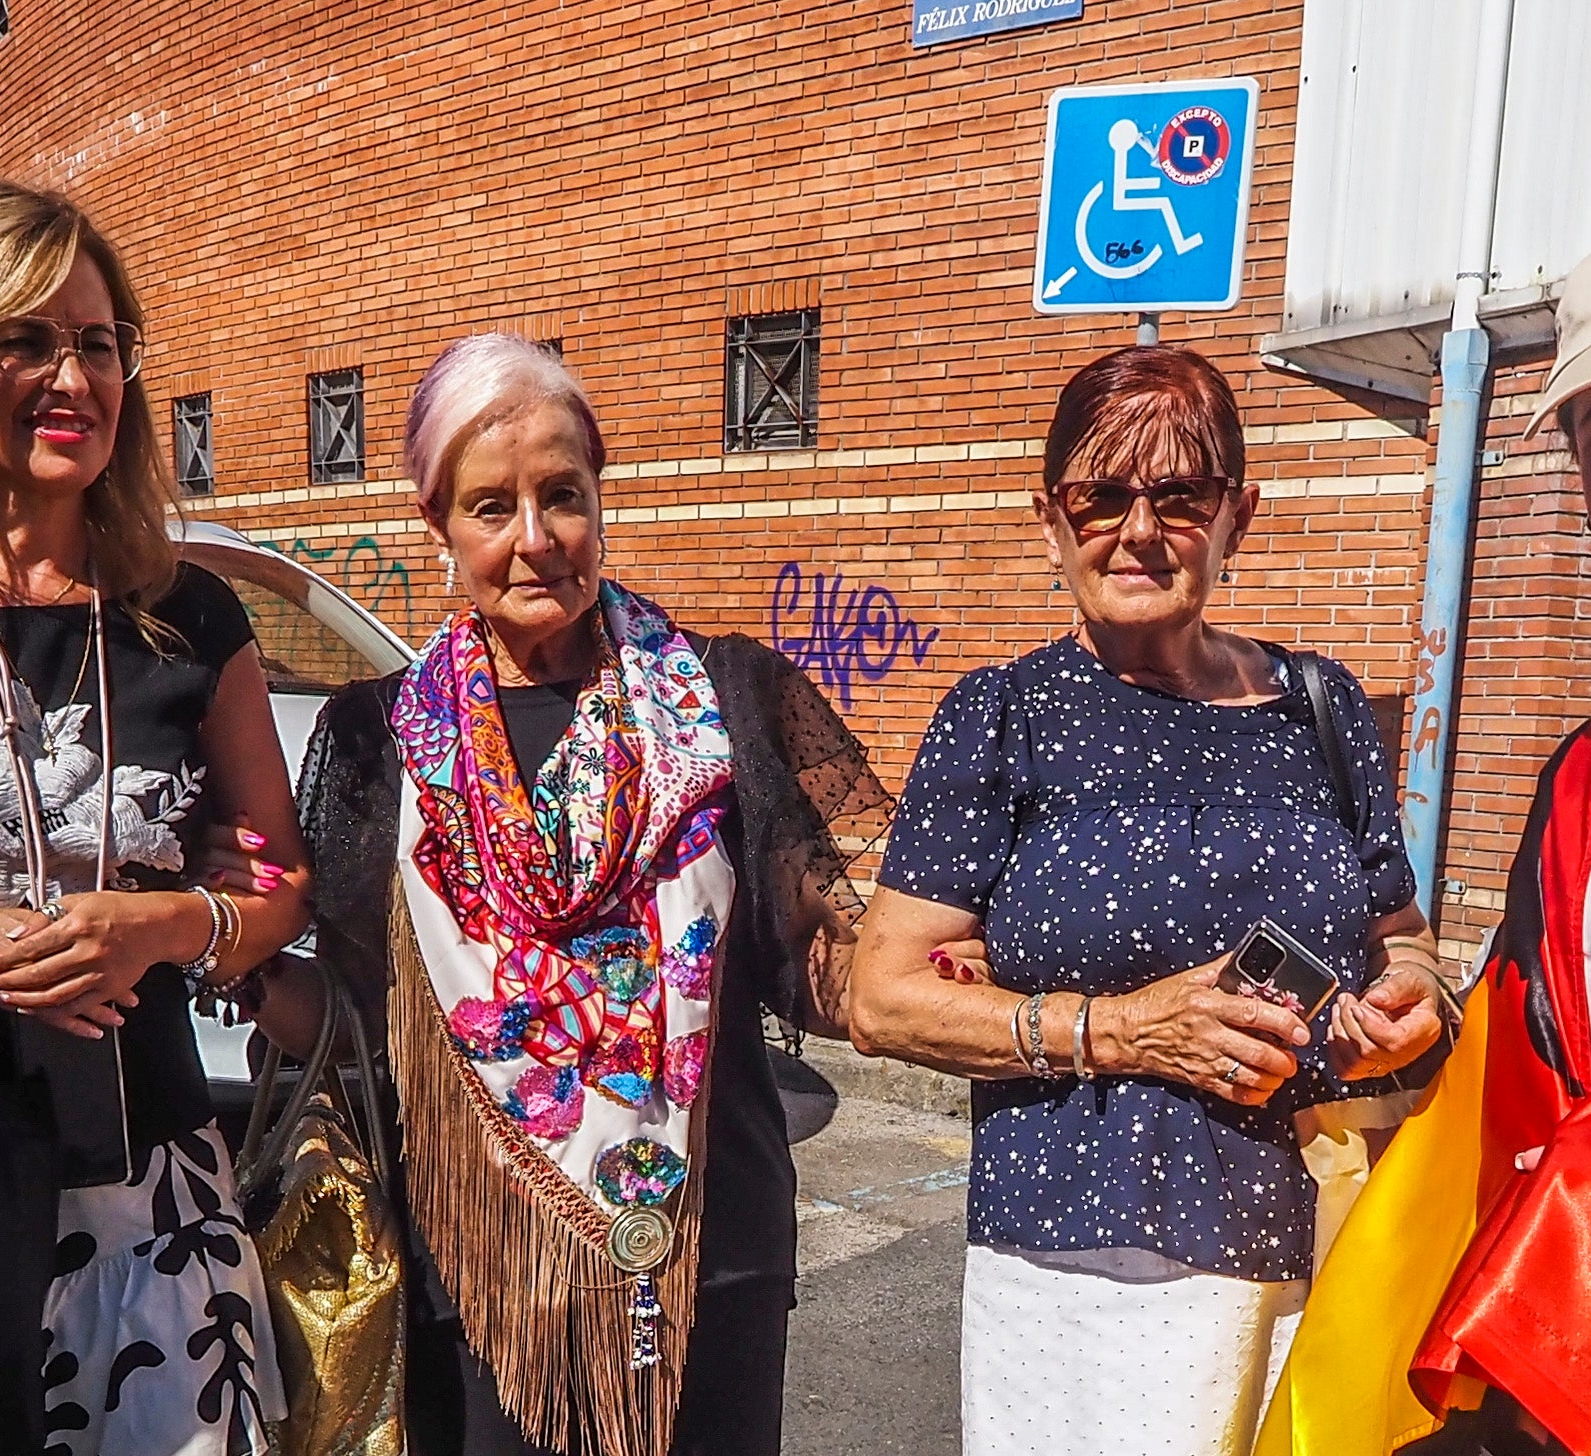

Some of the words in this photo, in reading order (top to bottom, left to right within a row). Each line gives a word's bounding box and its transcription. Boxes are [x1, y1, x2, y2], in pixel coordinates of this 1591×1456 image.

[917, 5, 969, 34] FÉLIX
[1170, 108, 1223, 128] EXCEPTO
[1188, 140, 1199, 153] P
[1161, 157, 1224, 185] DISCAPACIDAD
